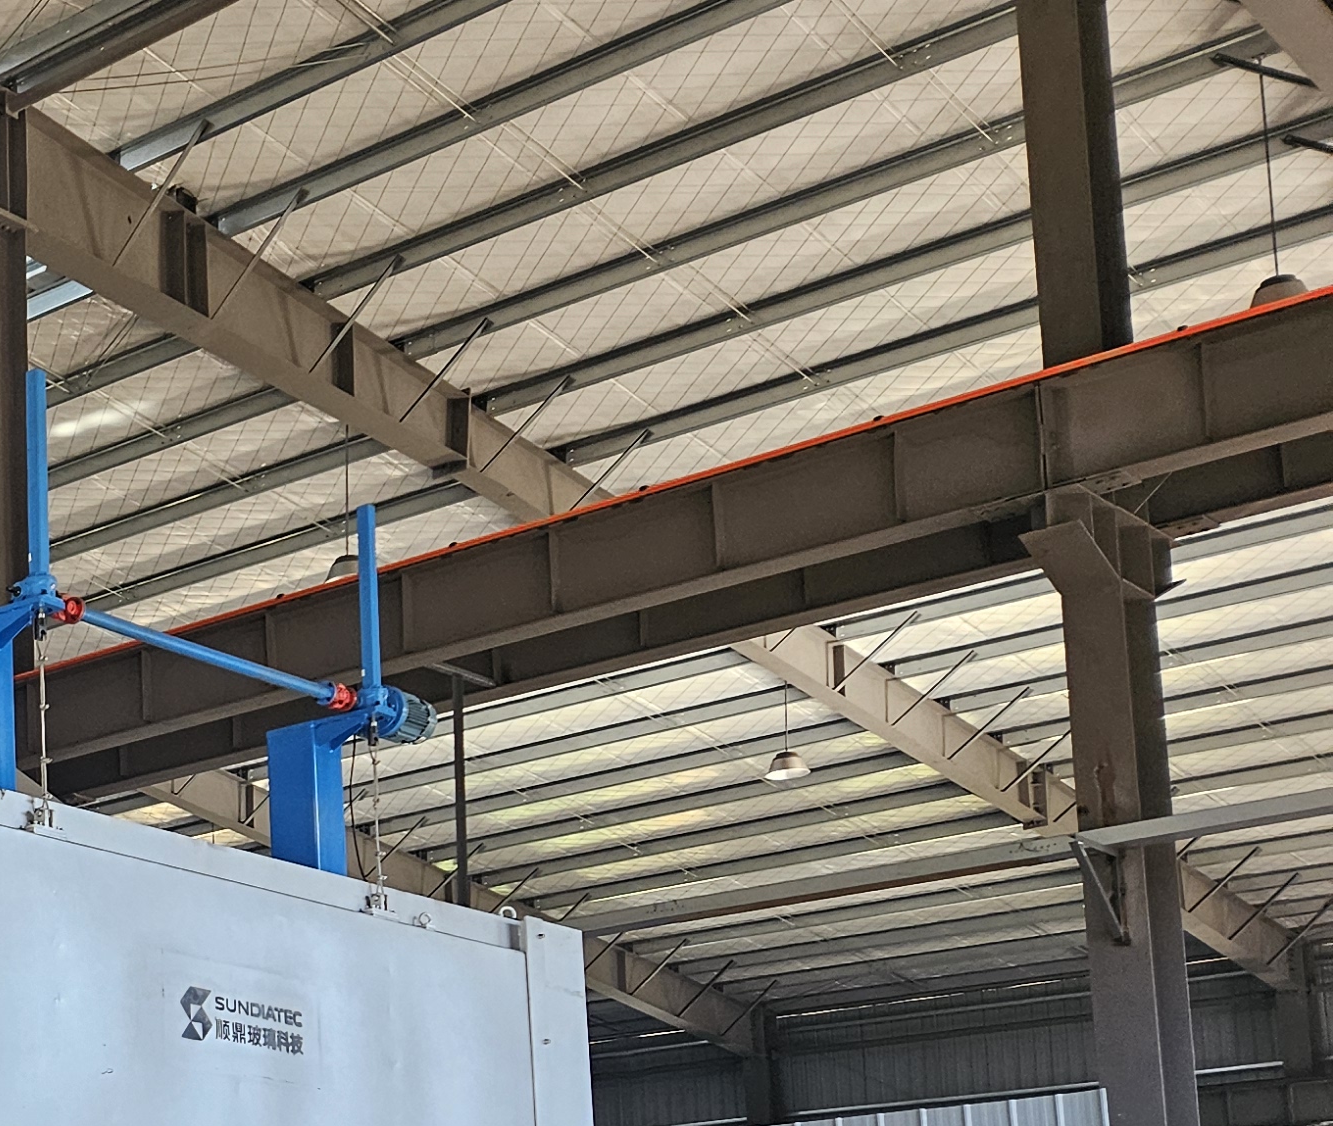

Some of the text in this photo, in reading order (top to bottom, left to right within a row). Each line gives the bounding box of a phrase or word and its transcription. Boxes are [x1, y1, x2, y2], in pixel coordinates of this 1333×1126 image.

[214, 996, 303, 1028] SUNDIATEC
[214, 1016, 304, 1055] 顺鼎玻璃科技
